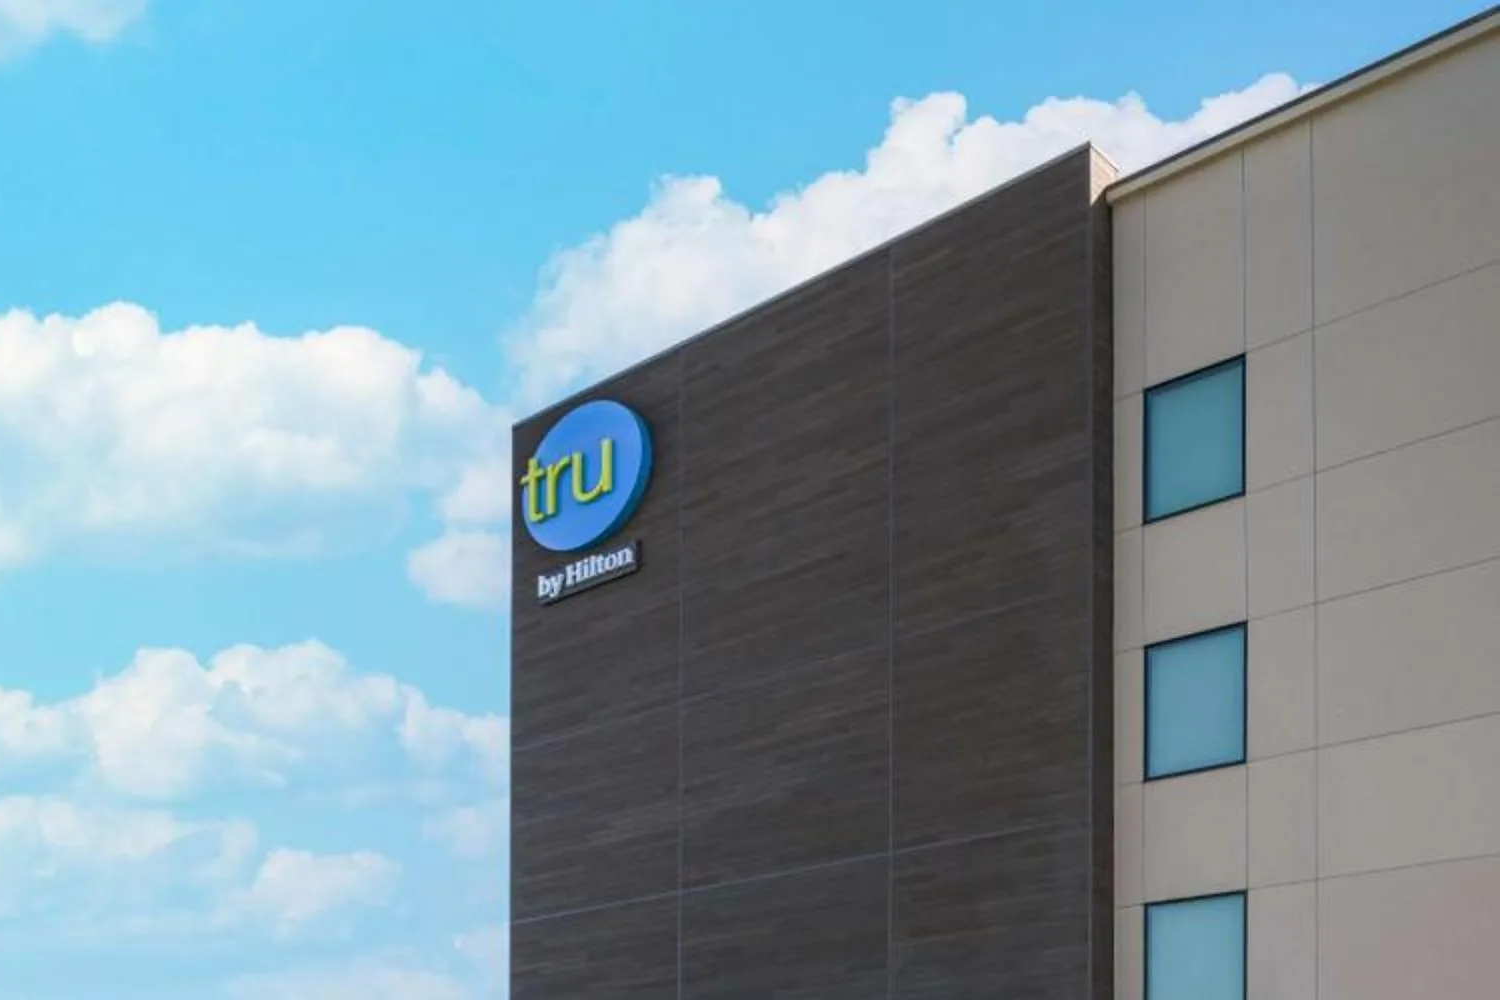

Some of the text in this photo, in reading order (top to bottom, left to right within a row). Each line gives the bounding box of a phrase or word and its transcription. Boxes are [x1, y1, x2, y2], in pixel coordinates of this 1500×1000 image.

[520, 438, 613, 522] tru
[537, 547, 634, 598] by Hilton
